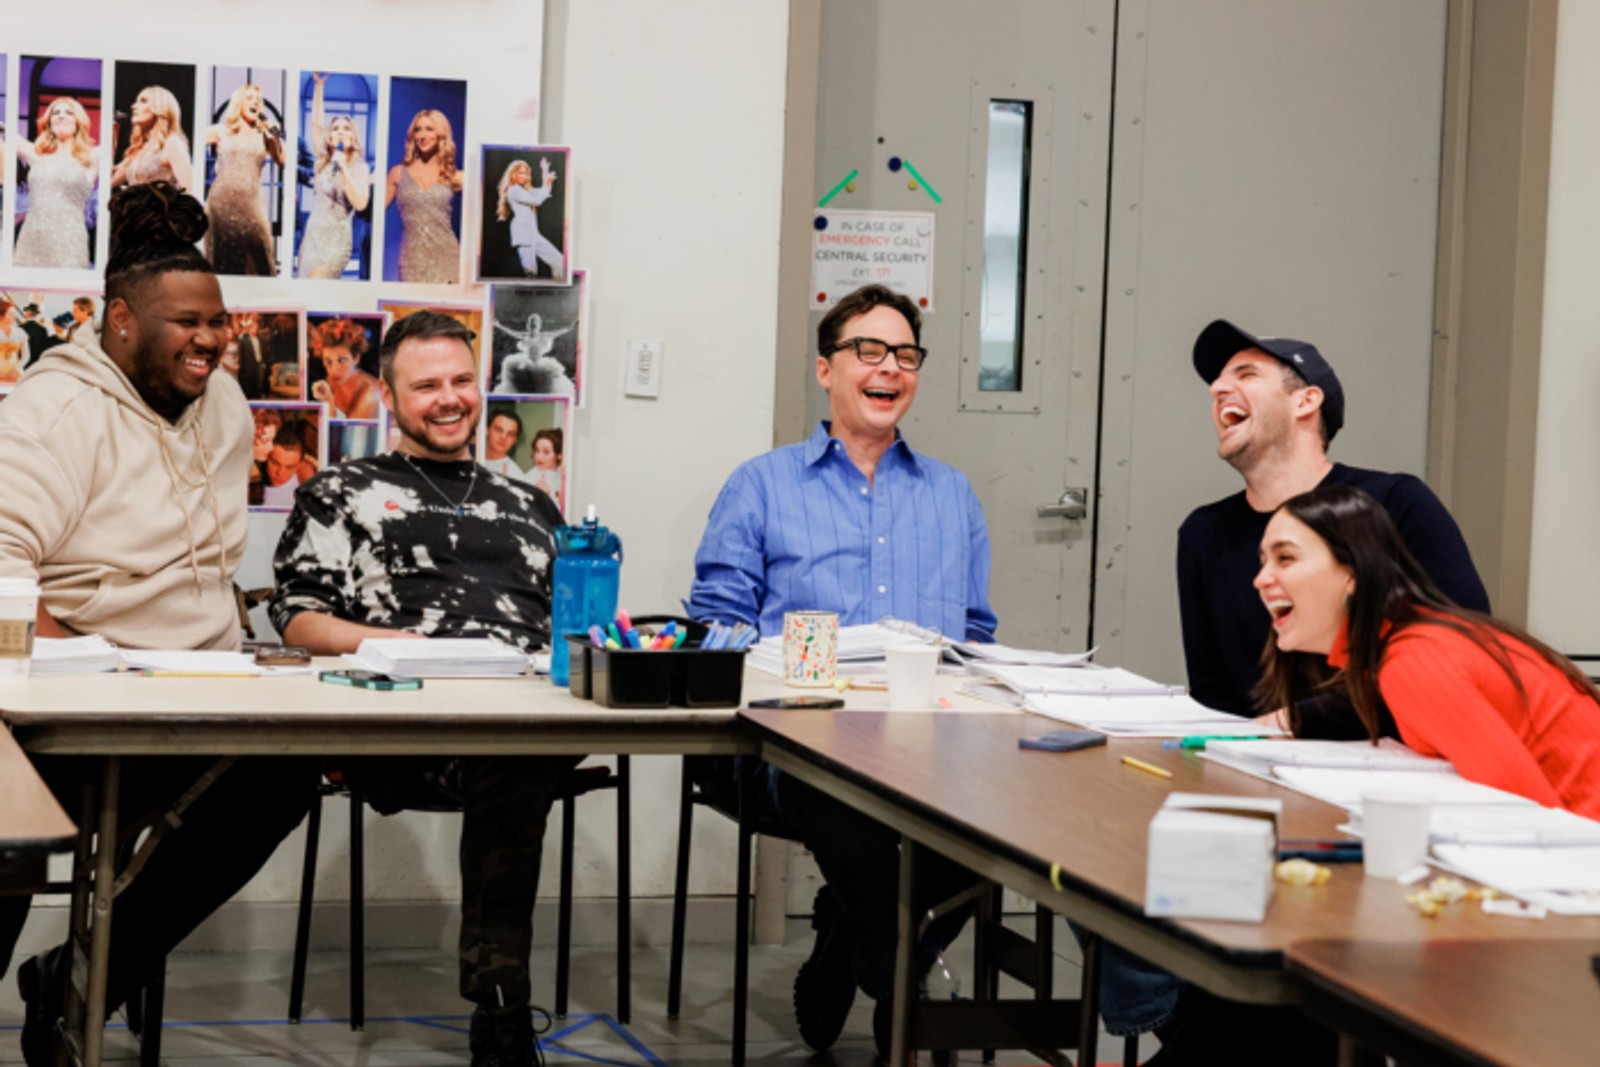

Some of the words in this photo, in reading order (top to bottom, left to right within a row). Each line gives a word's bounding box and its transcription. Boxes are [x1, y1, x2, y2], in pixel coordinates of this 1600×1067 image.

[841, 221, 852, 231] IN
[855, 221, 885, 232] CASE
[889, 222, 904, 233] OF
[819, 233, 891, 246] EMERGENCY
[894, 236, 923, 248] CALL
[815, 249, 869, 262] CENTRAL
[872, 251, 928, 263] SECURITY
